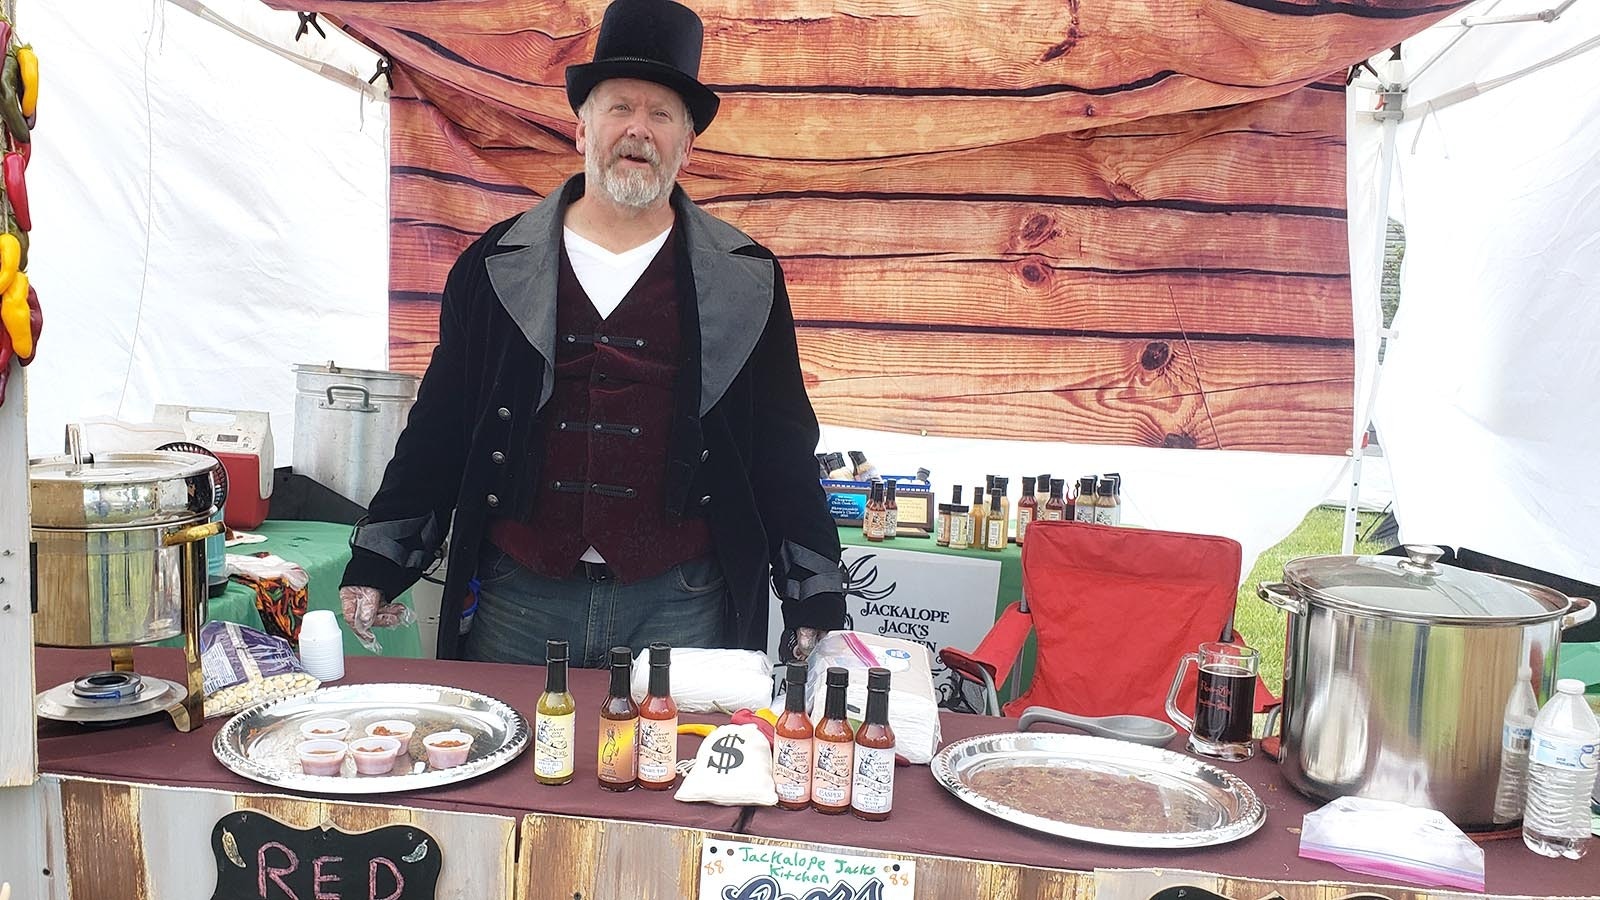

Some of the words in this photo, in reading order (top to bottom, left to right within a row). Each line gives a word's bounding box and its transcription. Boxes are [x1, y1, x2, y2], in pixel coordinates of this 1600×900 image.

[860, 602, 950, 624] JACKALOPE
[878, 619, 929, 640] JACK'S
[257, 841, 405, 900] RED
[739, 847, 826, 871] Jackalope
[834, 859, 876, 875] Jacks
[769, 864, 830, 884] Kitchen
